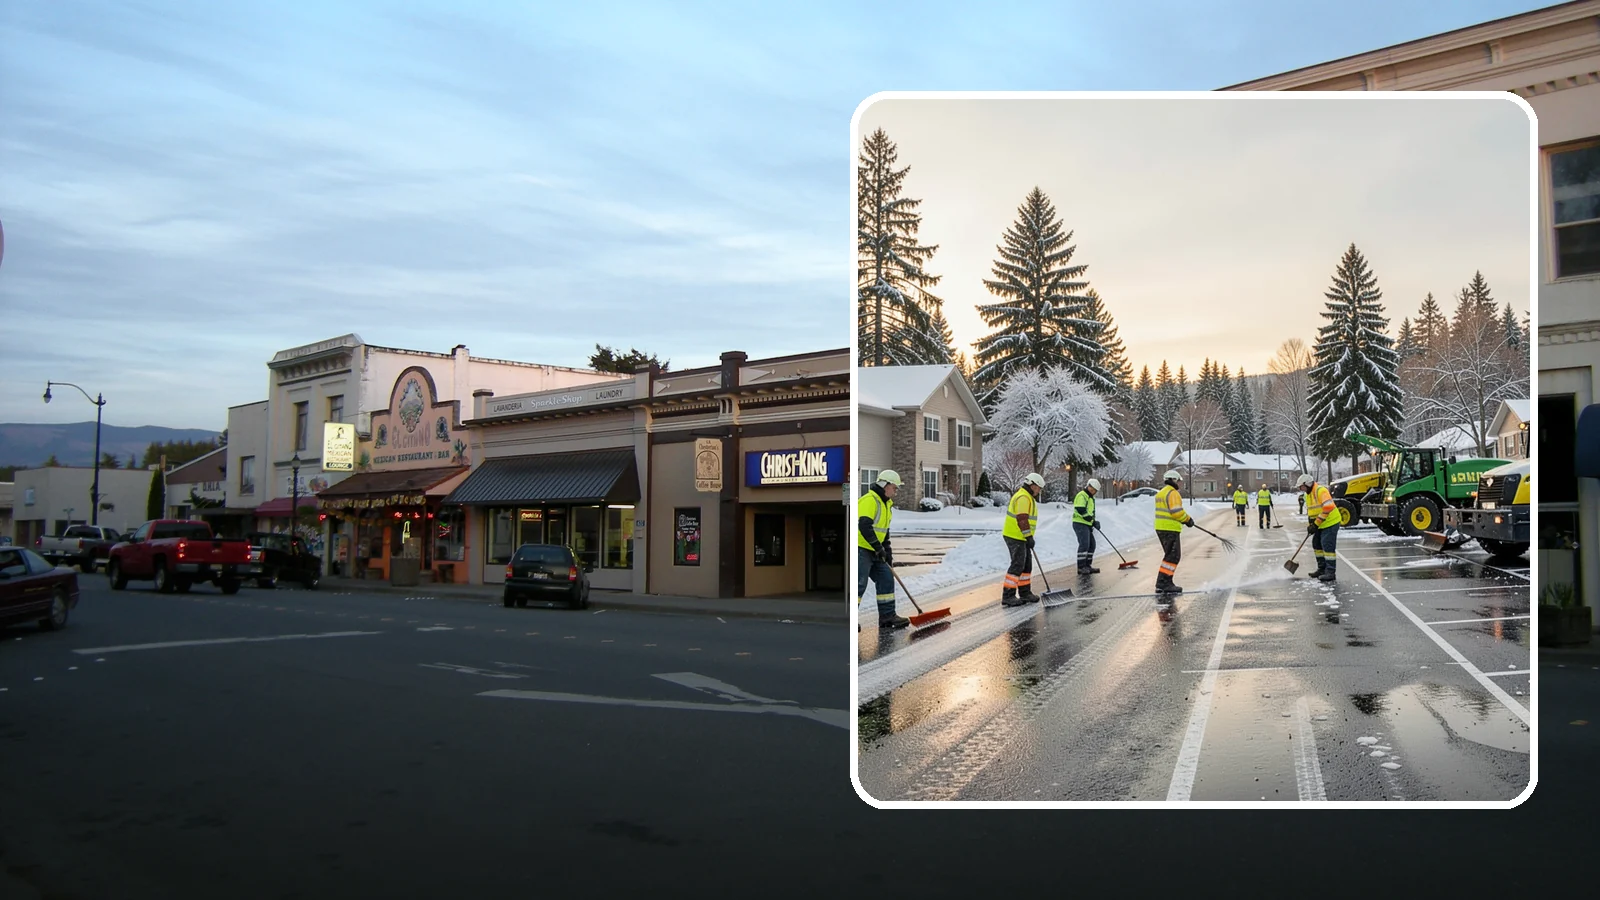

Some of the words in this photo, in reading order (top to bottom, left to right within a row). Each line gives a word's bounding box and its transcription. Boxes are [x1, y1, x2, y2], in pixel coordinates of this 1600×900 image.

[595, 389, 624, 400] LAUNDRY
[493, 402, 523, 413] LAVANDERIA
[531, 396, 559, 409] Sparkle
[560, 394, 582, 406] Shop
[398, 451, 433, 463] RESTAURANT
[438, 450, 450, 459] BAR
[761, 452, 797, 478] CHRIST
[799, 450, 827, 477] KING
